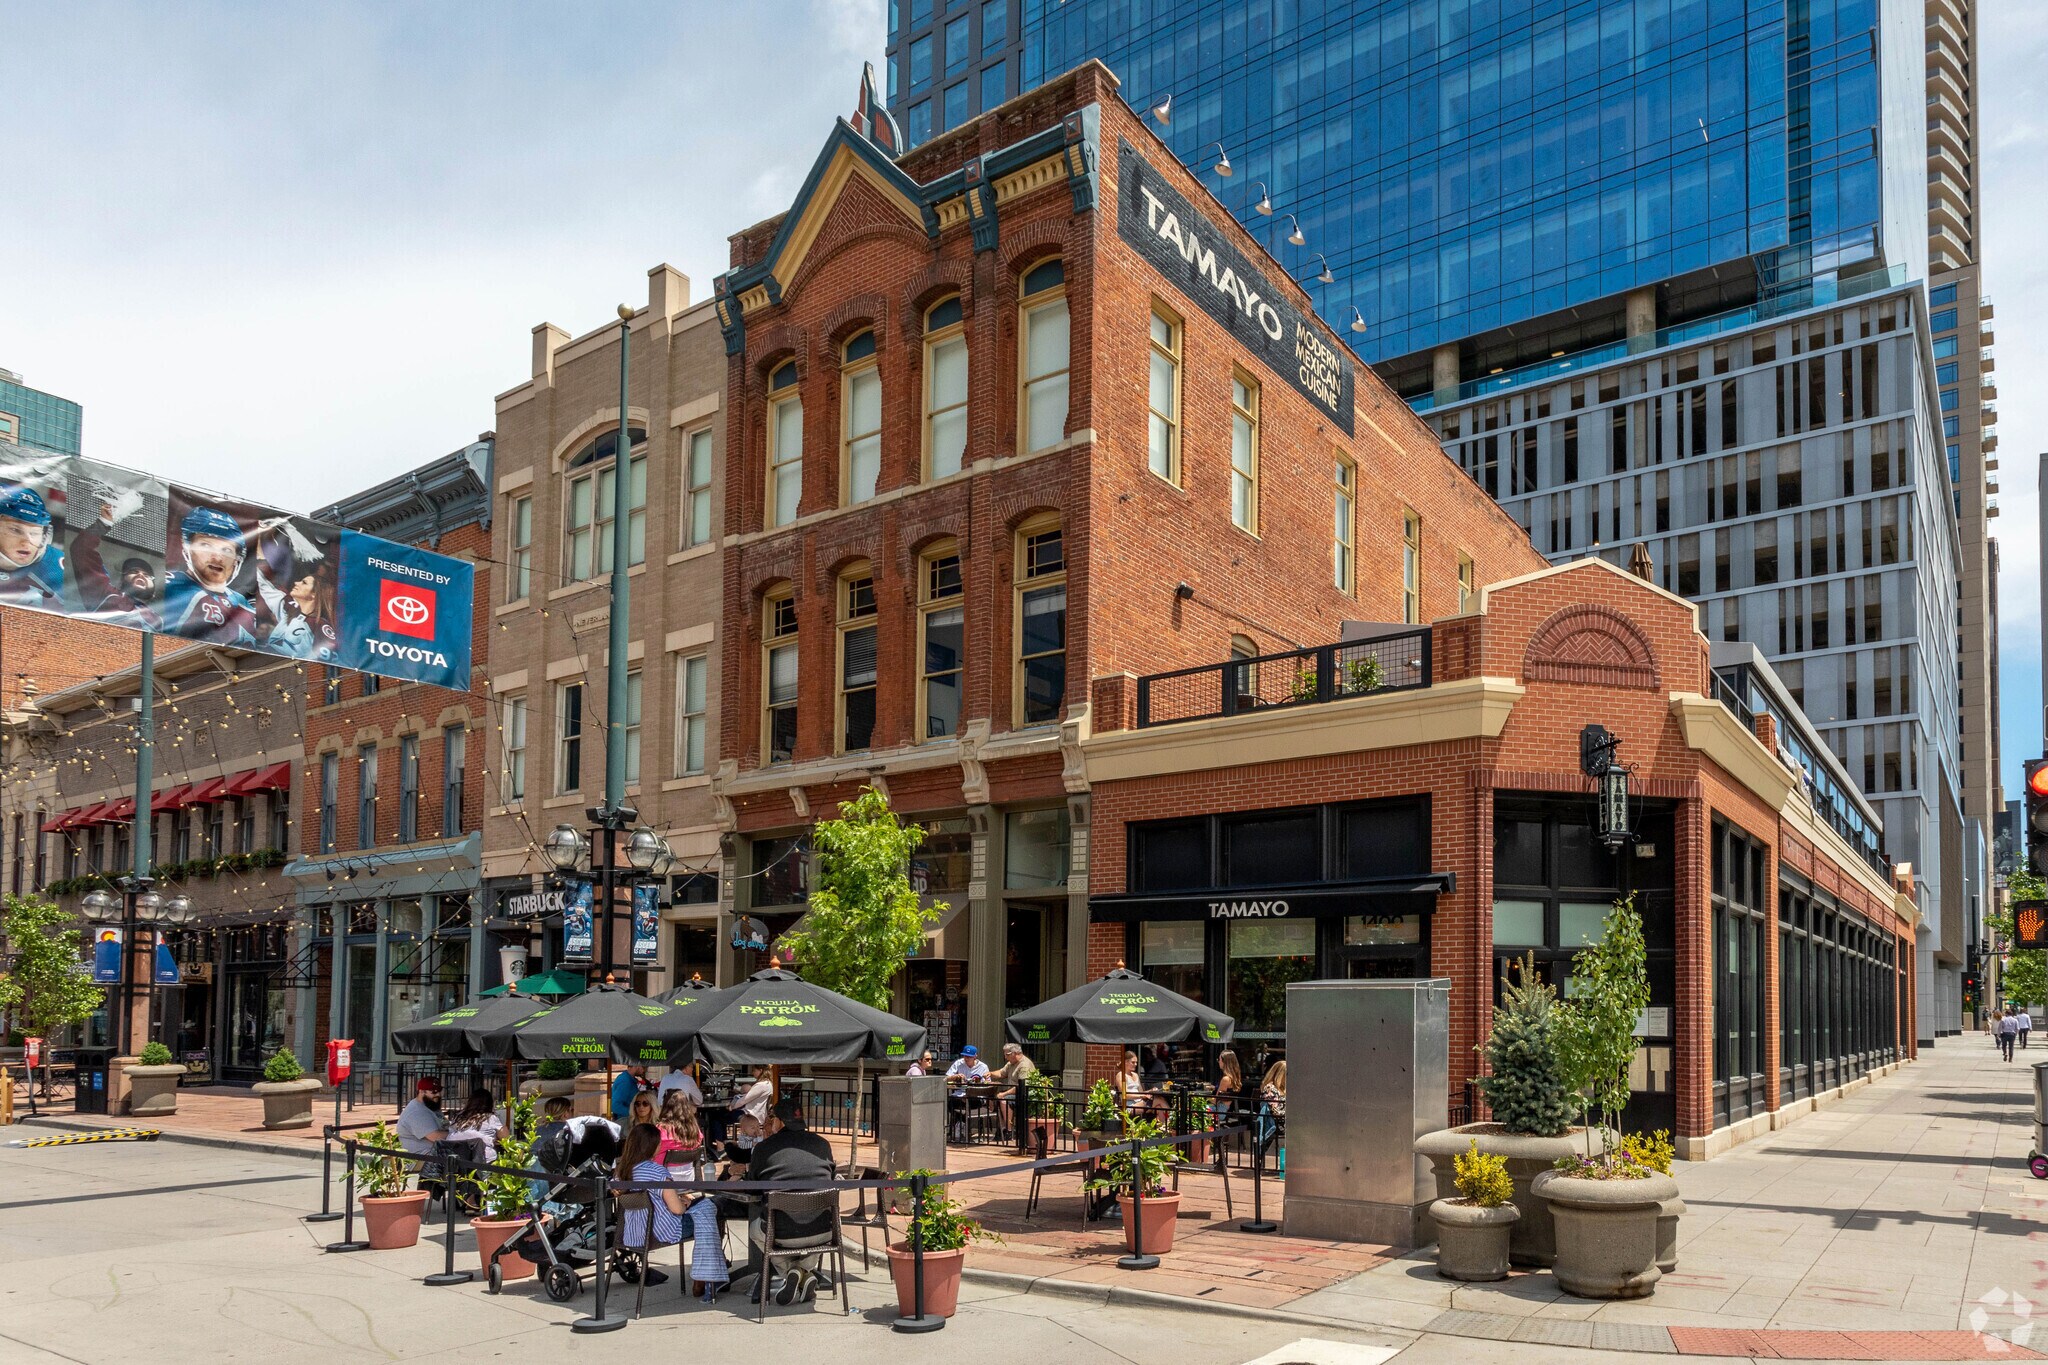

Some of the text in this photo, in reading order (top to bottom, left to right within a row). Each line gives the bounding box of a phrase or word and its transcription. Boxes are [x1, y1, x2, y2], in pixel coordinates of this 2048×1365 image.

[1141, 185, 1282, 341] TAMAYO
[1296, 321, 1340, 376] MODERN
[1295, 341, 1341, 396] MEXICAN
[1299, 365, 1338, 412] CUISINE
[368, 557, 451, 585] PRESENTED BY
[202, 602, 225, 626] 25
[366, 638, 448, 668] TOYOTA
[1615, 775, 1623, 831] TAMAYO
[509, 891, 565, 915] STARBUCK
[1208, 900, 1290, 918] TAMAYO
[1361, 914, 1404, 929] 1400
[733, 931, 747, 949] dog
